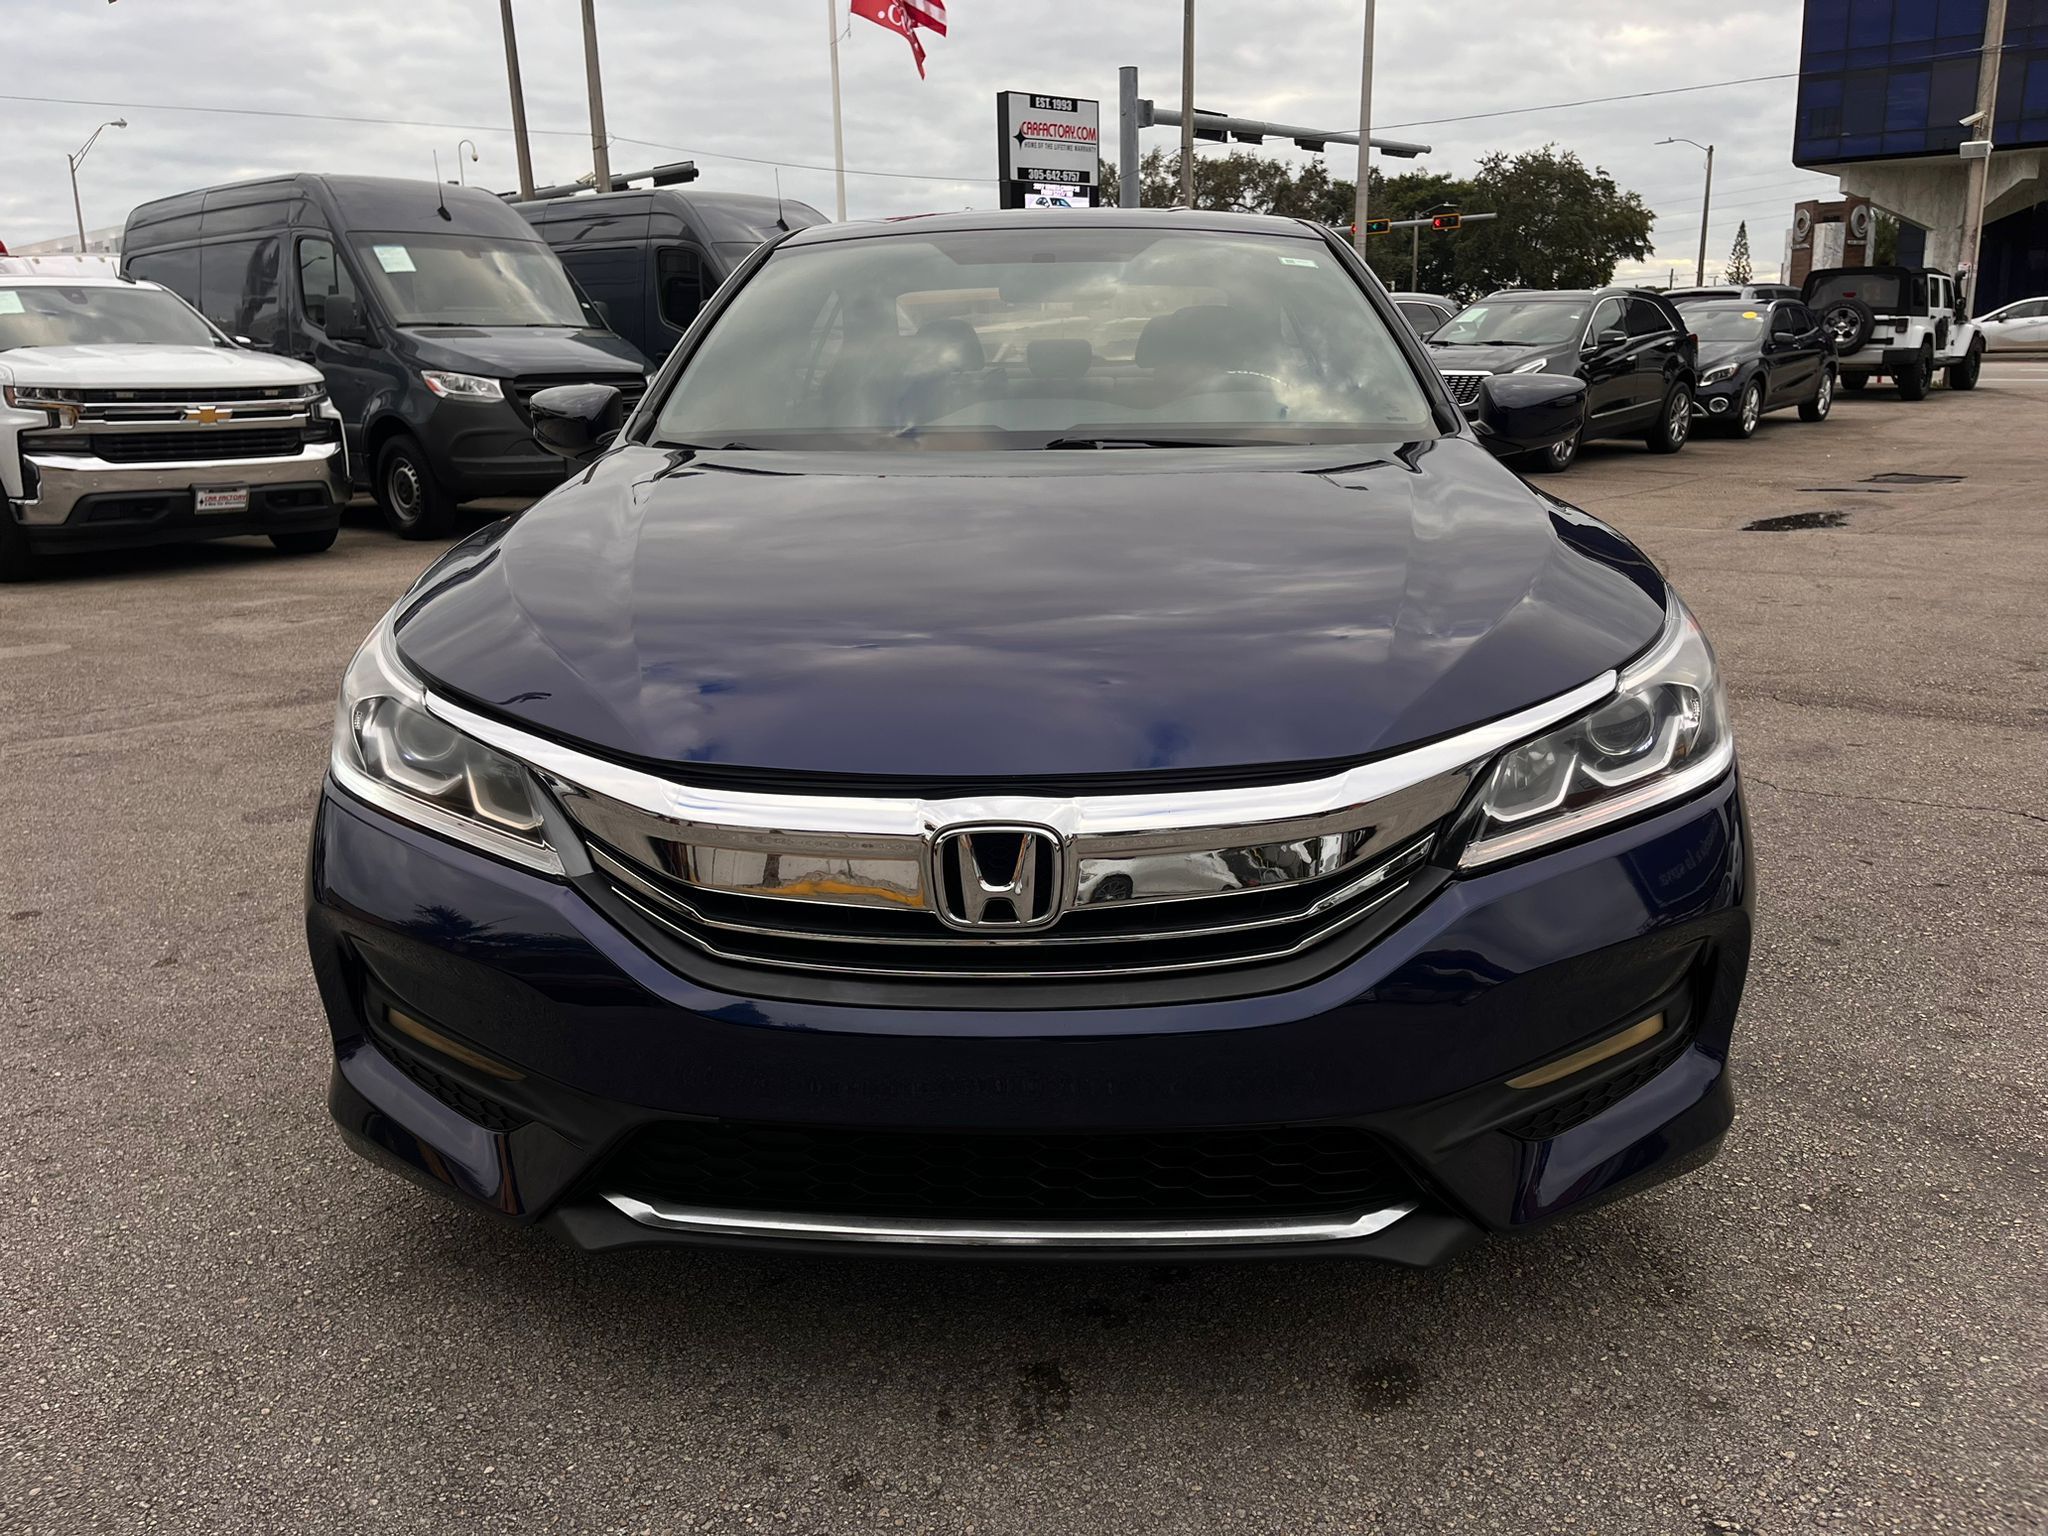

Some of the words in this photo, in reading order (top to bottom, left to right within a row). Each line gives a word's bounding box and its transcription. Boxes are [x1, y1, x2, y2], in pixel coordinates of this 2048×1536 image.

[1035, 97, 1051, 109] EST.
[1052, 99, 1072, 111] 1993
[1021, 121, 1097, 141] CARFACTORY.COM
[1028, 169, 1080, 182] 305-642-6757
